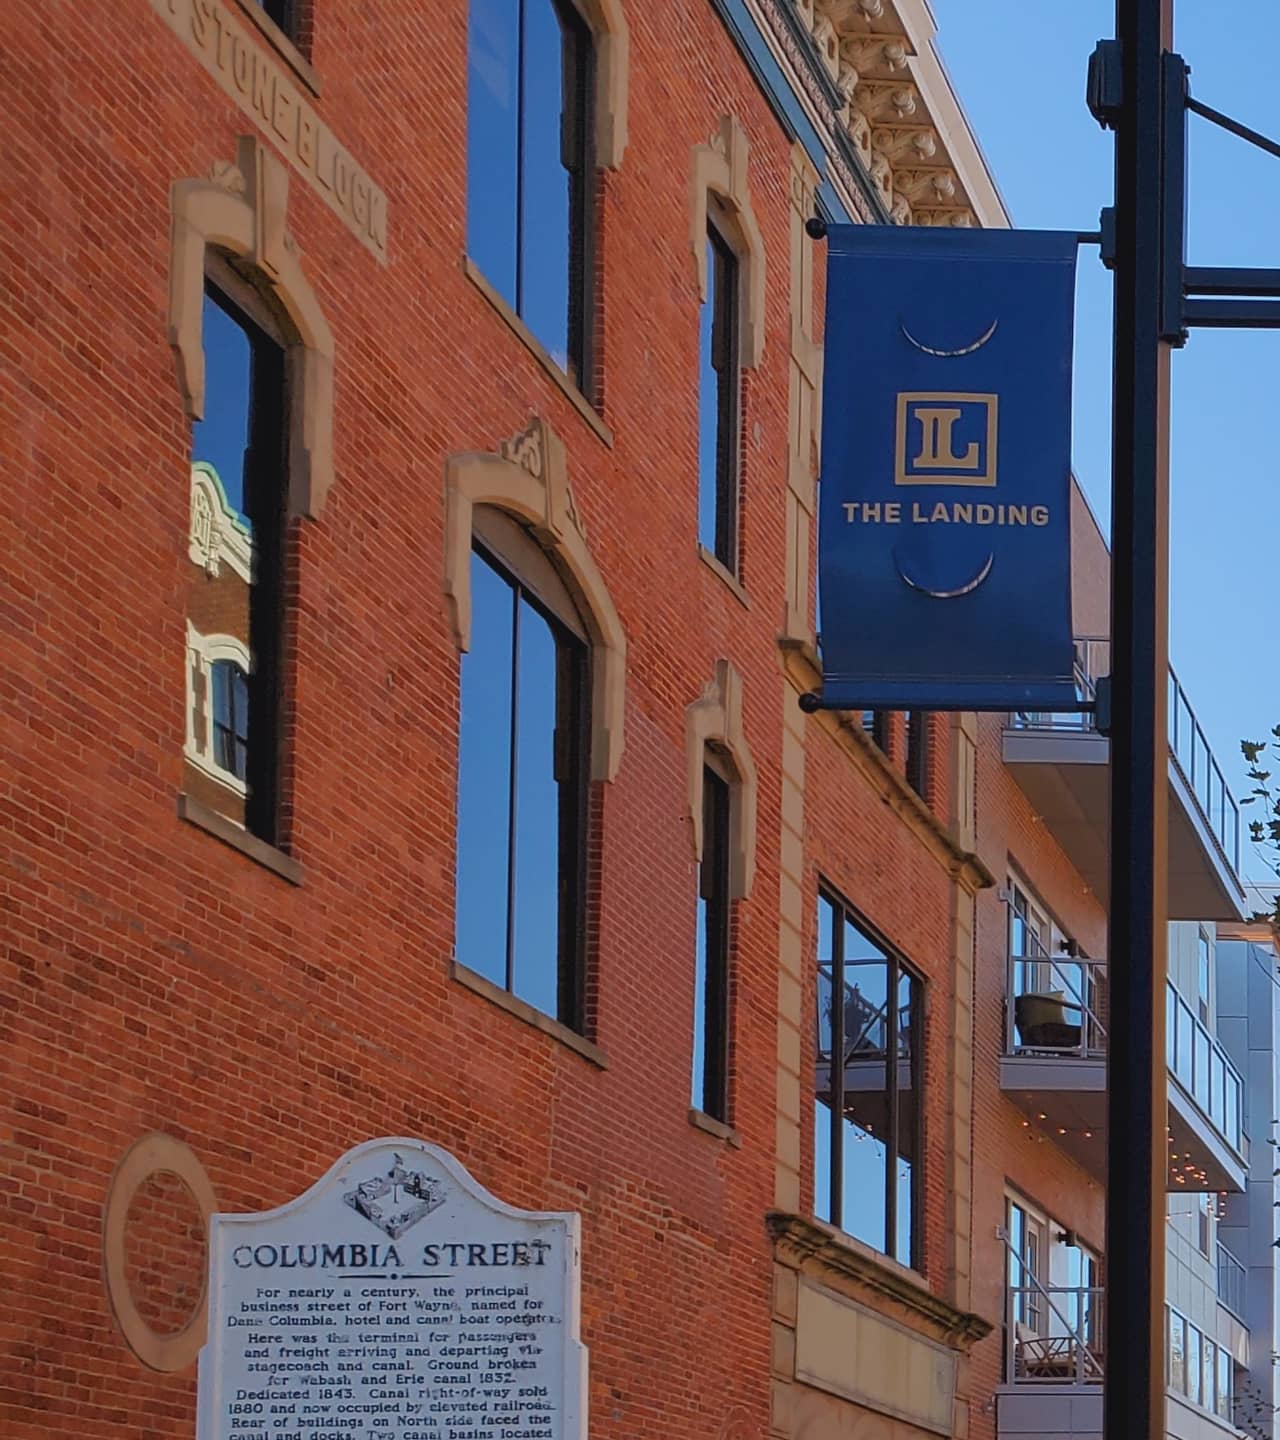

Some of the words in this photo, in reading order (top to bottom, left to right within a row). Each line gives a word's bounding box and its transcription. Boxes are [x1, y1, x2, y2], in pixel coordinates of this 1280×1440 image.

[296, 102, 384, 250] BLOCK
[841, 503, 902, 524] THE
[912, 503, 1050, 527] LANDING
[232, 1244, 405, 1267] COLUMBIA
[422, 1243, 552, 1266] STREET
[256, 1286, 281, 1297] For
[288, 1286, 335, 1300] nearly
[343, 1289, 352, 1297] a
[433, 1285, 456, 1296] the
[465, 1285, 529, 1299] principal
[240, 1301, 300, 1312] business
[307, 1300, 351, 1311] street
[358, 1300, 372, 1311] of
[378, 1300, 407, 1311] Fort
[471, 1299, 516, 1310] named
[523, 1299, 544, 1310] for
[344, 1314, 381, 1325] hotel
[385, 1314, 410, 1325] and
[459, 1313, 490, 1324] boat
[248, 1332, 283, 1343] Here
[291, 1335, 318, 1343] was
[358, 1332, 420, 1343] terminal
[429, 1332, 451, 1343] for
[244, 1347, 270, 1358] and
[278, 1346, 330, 1360] freight
[405, 1345, 430, 1356] and
[438, 1345, 509, 1359] departing
[247, 1361, 329, 1375] stagecoach
[337, 1360, 364, 1371] and
[372, 1360, 414, 1371] canal.
[427, 1359, 479, 1370] Ground
[488, 1359, 537, 1370] broken
[360, 1374, 387, 1385] and
[396, 1373, 425, 1384] Erie
[432, 1373, 472, 1384] canal
[236, 1389, 310, 1400] Dedicated
[319, 1388, 356, 1399] 1843.
[368, 1387, 410, 1398] Canal
[518, 1386, 548, 1397] sold
[228, 1403, 264, 1414] 1880
[270, 1402, 296, 1413] and
[302, 1404, 332, 1413] now
[336, 1401, 400, 1415] occupied
[406, 1400, 423, 1414] by
[231, 1417, 266, 1428] Rear
[273, 1416, 289, 1427] of
[296, 1416, 364, 1430] buildings
[372, 1418, 389, 1426] on
[396, 1415, 438, 1426] North
[444, 1415, 474, 1426] side
[481, 1414, 520, 1425] faced
[528, 1414, 551, 1425] the
[275, 1430, 303, 1440] and
[310, 1430, 356, 1440] docks.
[403, 1429, 442, 1440] canal
[448, 1428, 494, 1439] basins
[500, 1428, 552, 1439] located
